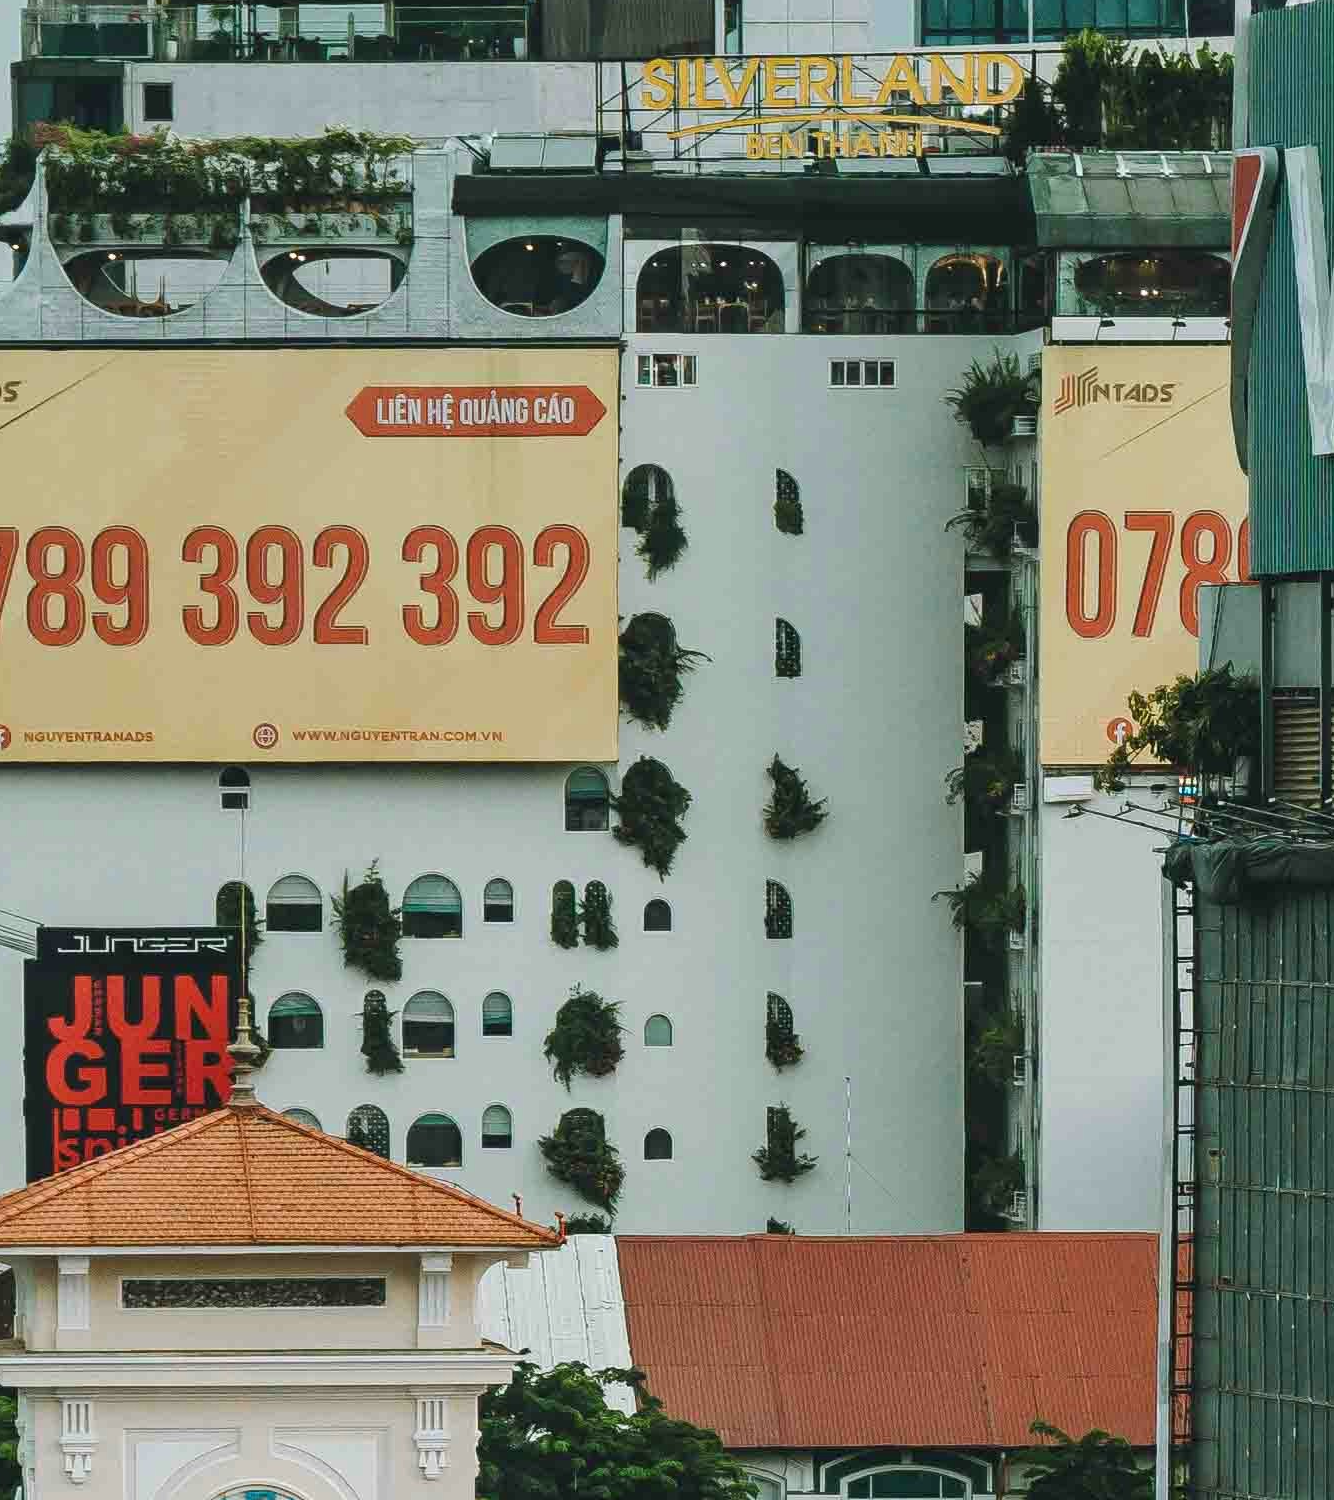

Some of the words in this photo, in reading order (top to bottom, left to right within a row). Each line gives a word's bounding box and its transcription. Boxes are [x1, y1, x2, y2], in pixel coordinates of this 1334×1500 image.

[641, 53, 1024, 110] SILVERLAND
[377, 392, 421, 426] LIÊN
[426, 392, 455, 430] HỆ
[458, 387, 529, 426] QUẢNG
[533, 391, 576, 425] CÁO
[181, 524, 370, 648] 392
[401, 524, 591, 648] 392
[23, 730, 155, 744] NGUYENTRANADS
[291, 729, 504, 743] WWW.NGUYENTRAN.COM.VN
[57, 935, 227, 954] JUNGER
[46, 973, 231, 1041] JUN
[45, 1038, 235, 1106] GER
